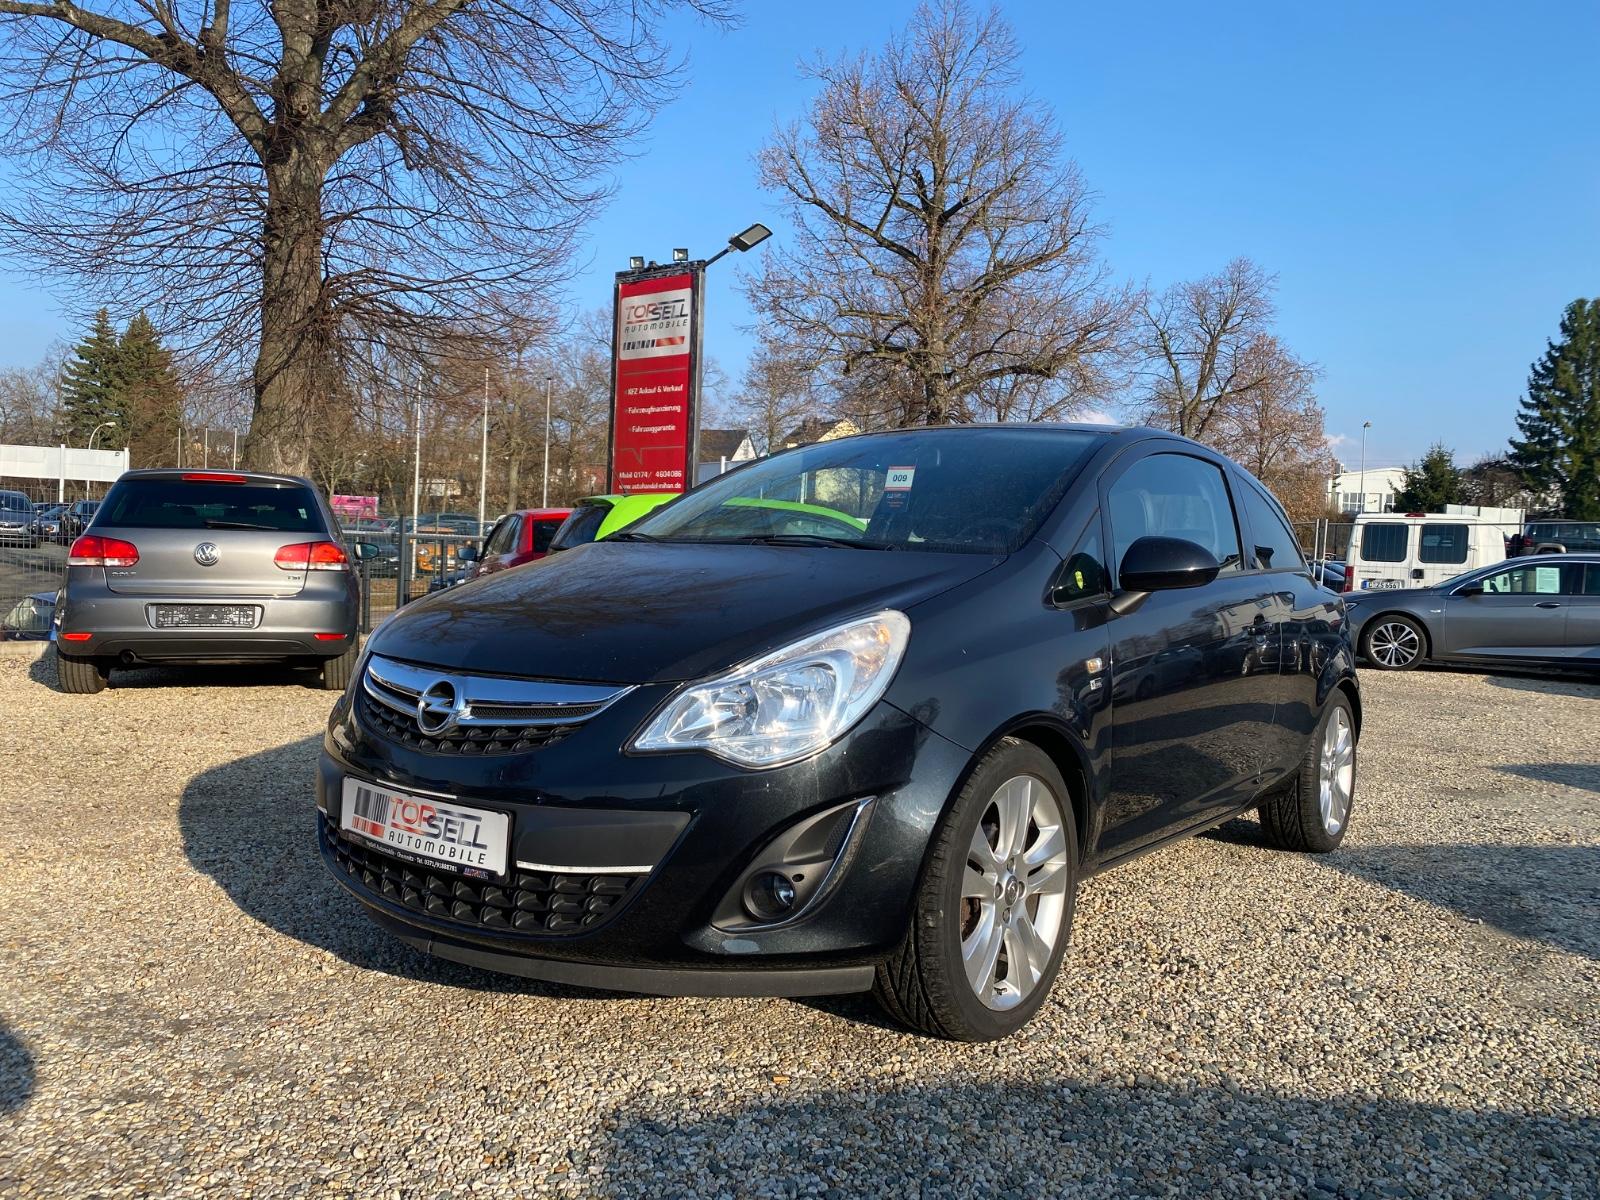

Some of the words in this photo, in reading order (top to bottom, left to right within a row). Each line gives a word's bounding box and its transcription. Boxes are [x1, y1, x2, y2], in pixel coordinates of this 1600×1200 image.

[625, 299, 688, 325] TOPSELL
[625, 319, 688, 333] AUTOMOBILE
[628, 387, 638, 395] KFZ
[662, 384, 684, 392] Verkauf
[628, 405, 681, 414] Fahrzeugfinanzierung
[632, 425, 676, 433] Fahrzeuggarantie
[390, 797, 488, 850] TOPSELL
[388, 831, 487, 865] AUTOMOBILE
